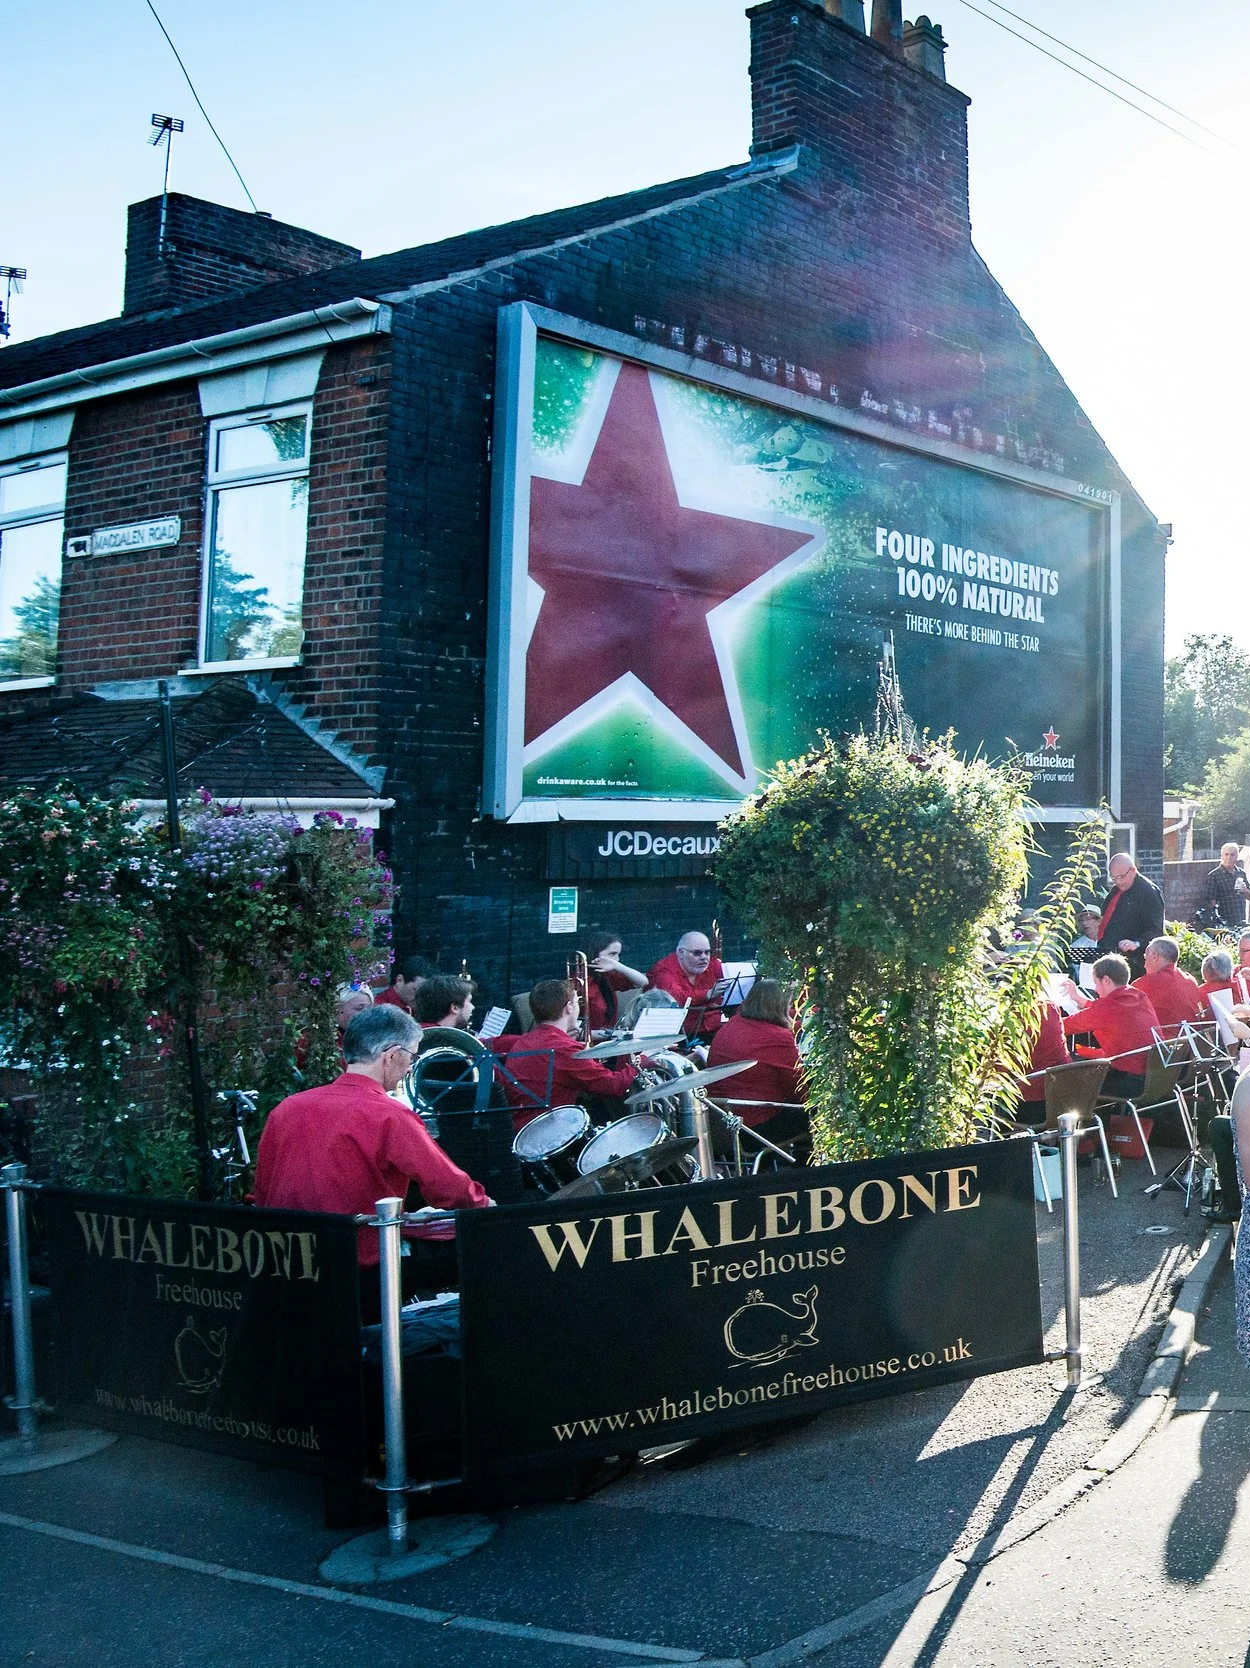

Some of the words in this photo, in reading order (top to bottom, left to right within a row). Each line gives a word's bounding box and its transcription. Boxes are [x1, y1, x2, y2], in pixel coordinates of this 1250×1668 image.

[1077, 482, 1113, 503] 041901
[94, 528, 145, 551] MAGDALEN
[148, 524, 176, 540] ROAD
[875, 526, 935, 568] FOUR
[942, 543, 1059, 597] INGREDIENTS
[897, 566, 958, 606] 100%
[962, 581, 1045, 624] NATURAL
[905, 613, 942, 637] THERE'S
[944, 621, 969, 641] MORE
[971, 626, 1001, 646] BEHIND
[1003, 631, 1019, 649] THE
[1021, 635, 1040, 653] STAR
[1023, 752, 1075, 769] Heineken
[1043, 773, 1057, 783] your
[1057, 772, 1075, 782] world
[537, 776, 606, 786] drinkaware.co.uk
[598, 830, 722, 857] JCDecaux
[527, 1165, 982, 1273] WHALEBONE
[73, 1210, 320, 1283] WHALEBONE
[689, 1244, 847, 1289] Freehouse
[155, 1273, 243, 1311] Freehouse
[551, 1337, 974, 1443] www.whalebonefreehouse.co.uk
